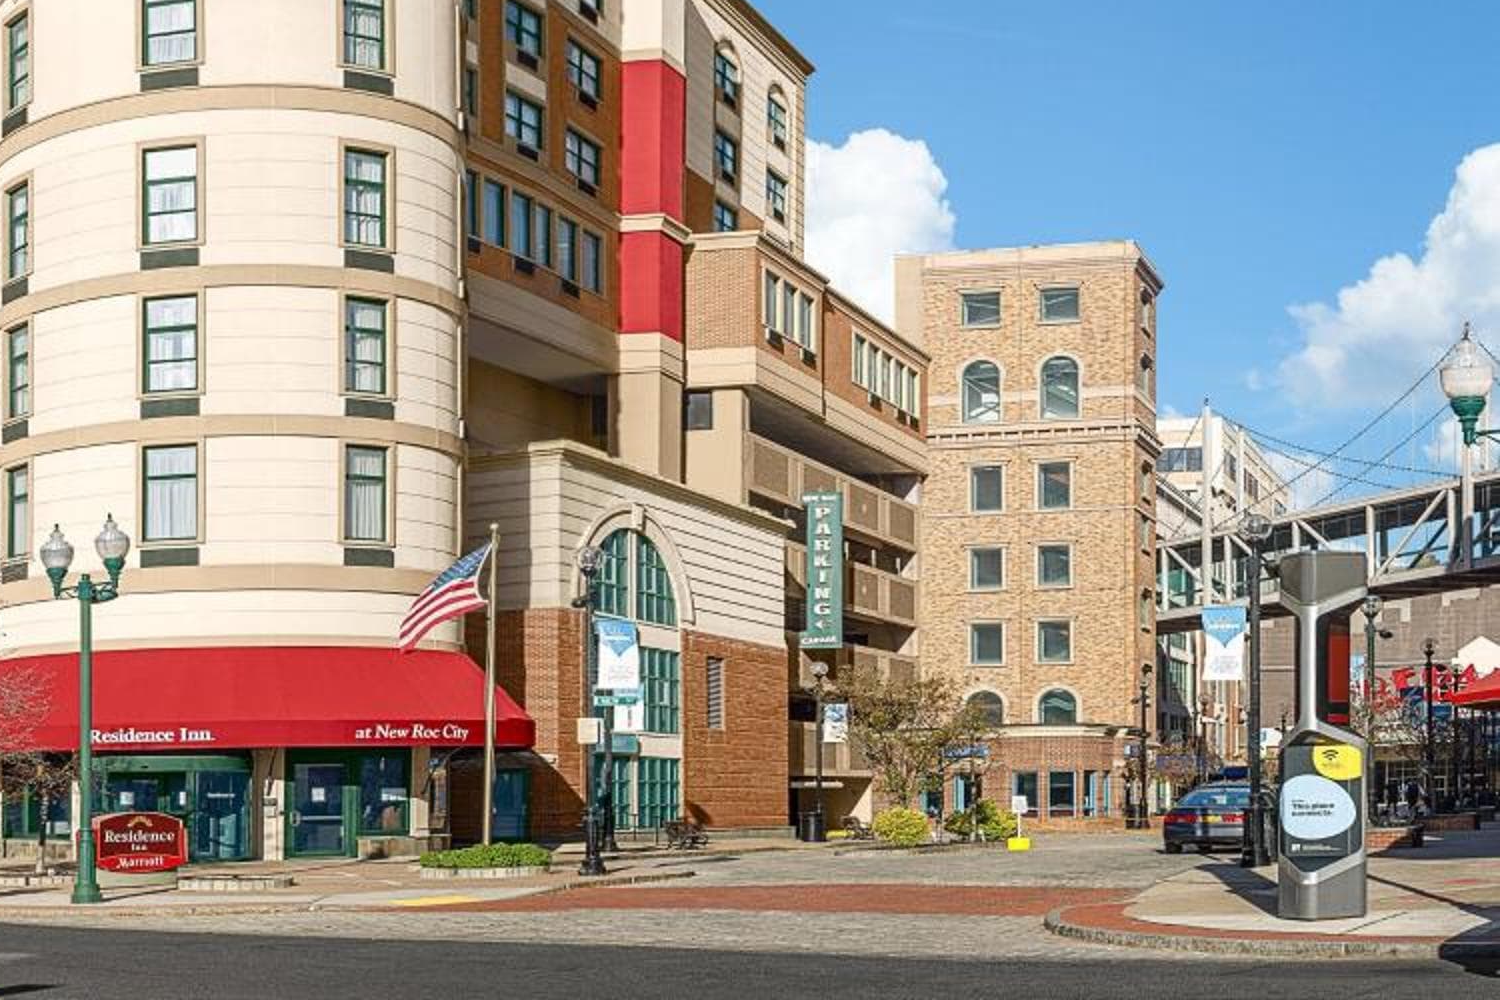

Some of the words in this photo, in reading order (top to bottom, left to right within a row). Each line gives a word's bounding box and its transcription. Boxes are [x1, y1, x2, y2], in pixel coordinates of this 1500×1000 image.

[813, 507, 832, 615] PARKING
[90, 727, 175, 744] Residence
[355, 728, 373, 739] at
[375, 724, 409, 739] New
[411, 723, 440, 739] Roc
[442, 723, 469, 742] City
[103, 829, 175, 843] Residence
[115, 855, 164, 869] Marriott
